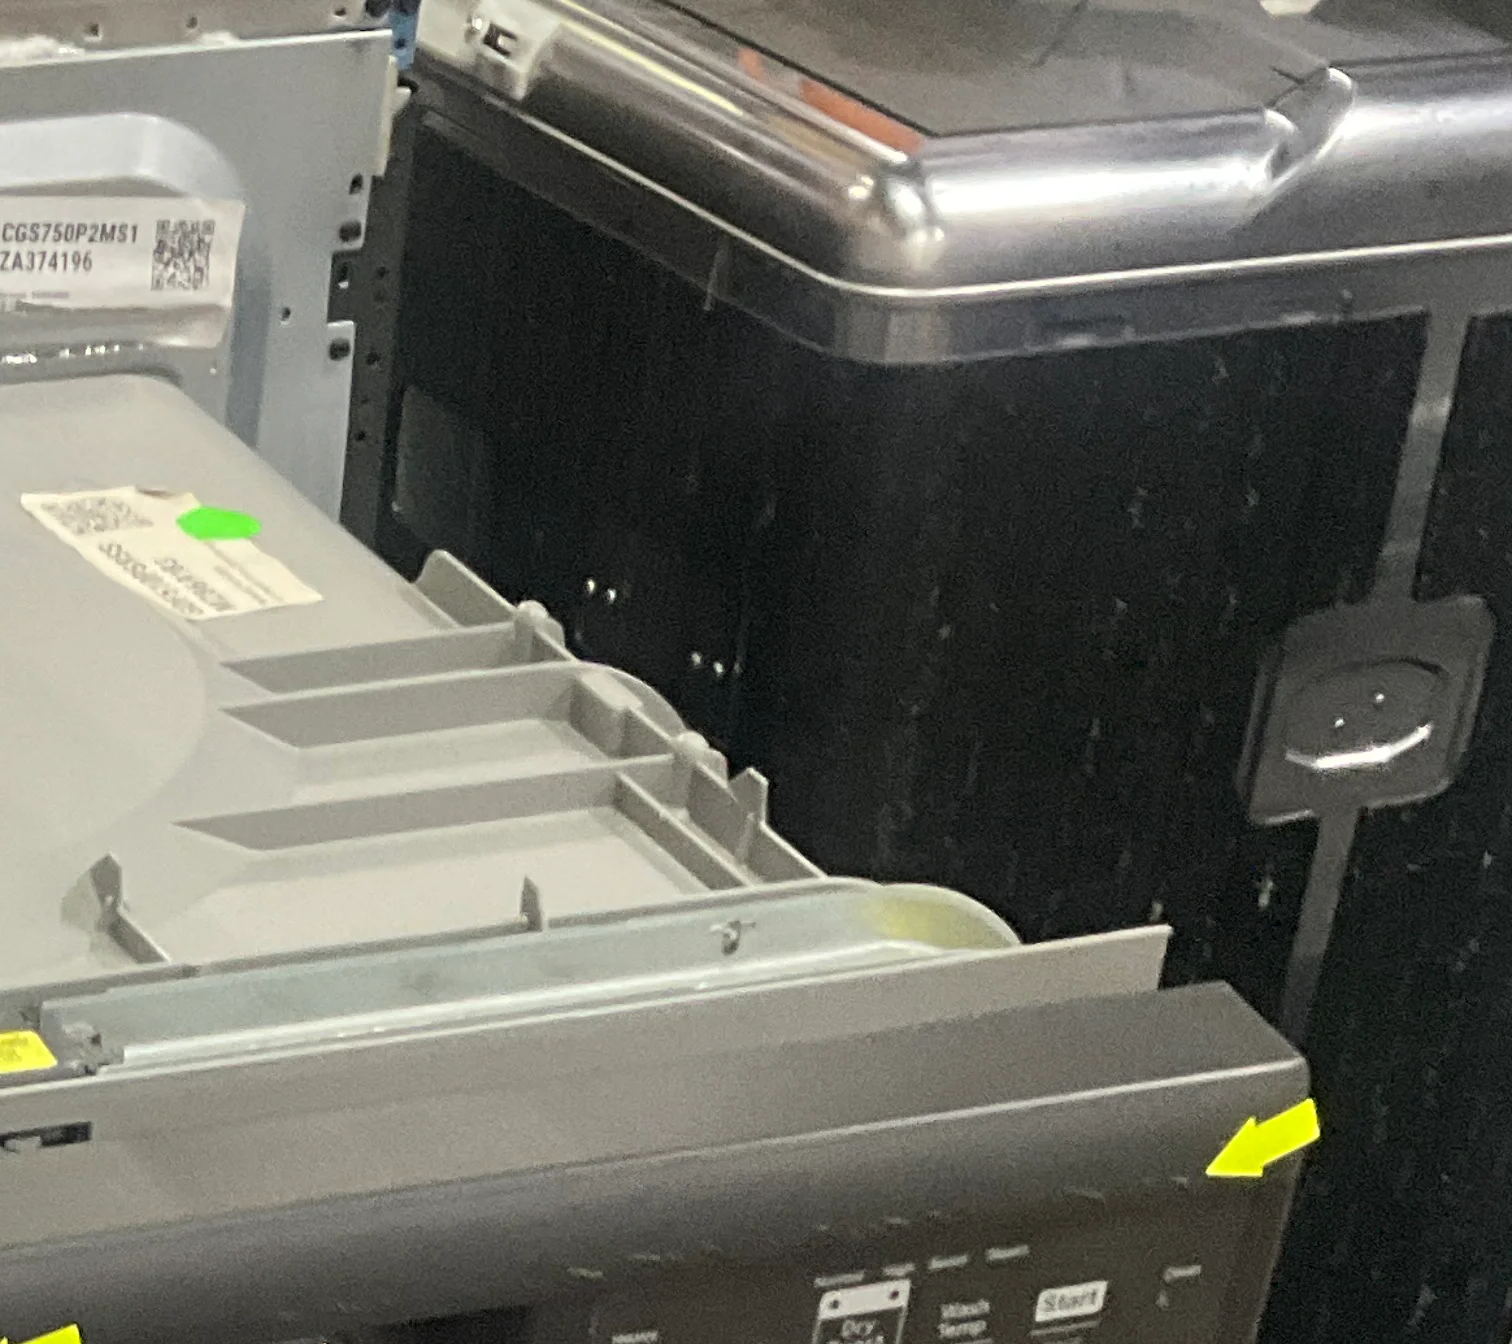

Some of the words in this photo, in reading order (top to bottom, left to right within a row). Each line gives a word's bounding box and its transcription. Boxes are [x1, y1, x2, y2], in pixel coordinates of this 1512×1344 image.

[1, 222, 139, 244] CGS750P2MS1
[0, 250, 93, 273] ZA374196
[1039, 1287, 1099, 1314] Start
